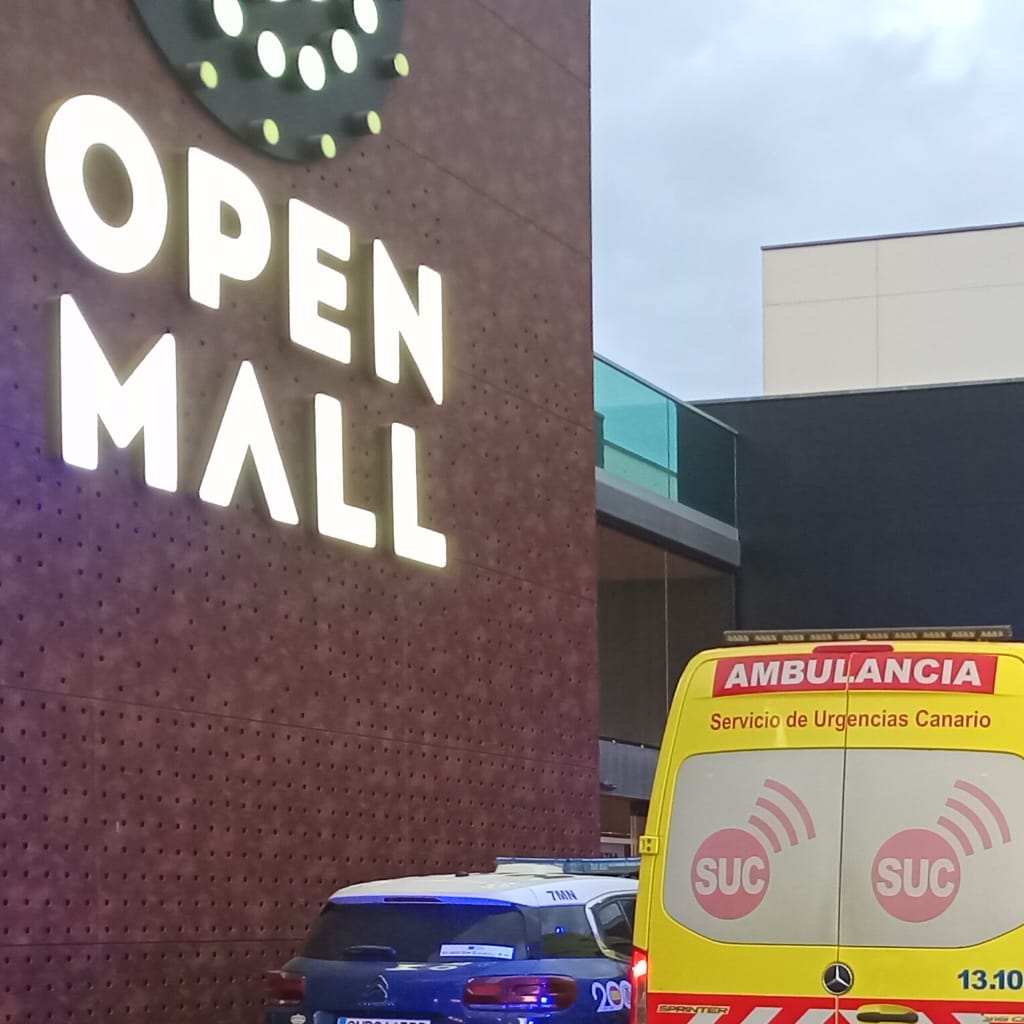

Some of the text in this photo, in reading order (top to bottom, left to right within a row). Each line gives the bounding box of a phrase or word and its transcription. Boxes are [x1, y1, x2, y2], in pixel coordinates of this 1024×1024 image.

[45, 94, 443, 405] OPEN
[60, 293, 447, 568] MALL
[724, 658, 982, 689] AMBULANCIA
[711, 709, 991, 732] Servicio de Urgencias Canario
[695, 856, 766, 896] SUC
[876, 858, 955, 898] SUC
[545, 889, 578, 901] 7MN
[957, 969, 1023, 990] 13.10
[659, 1005, 728, 1014] SPRINTER
